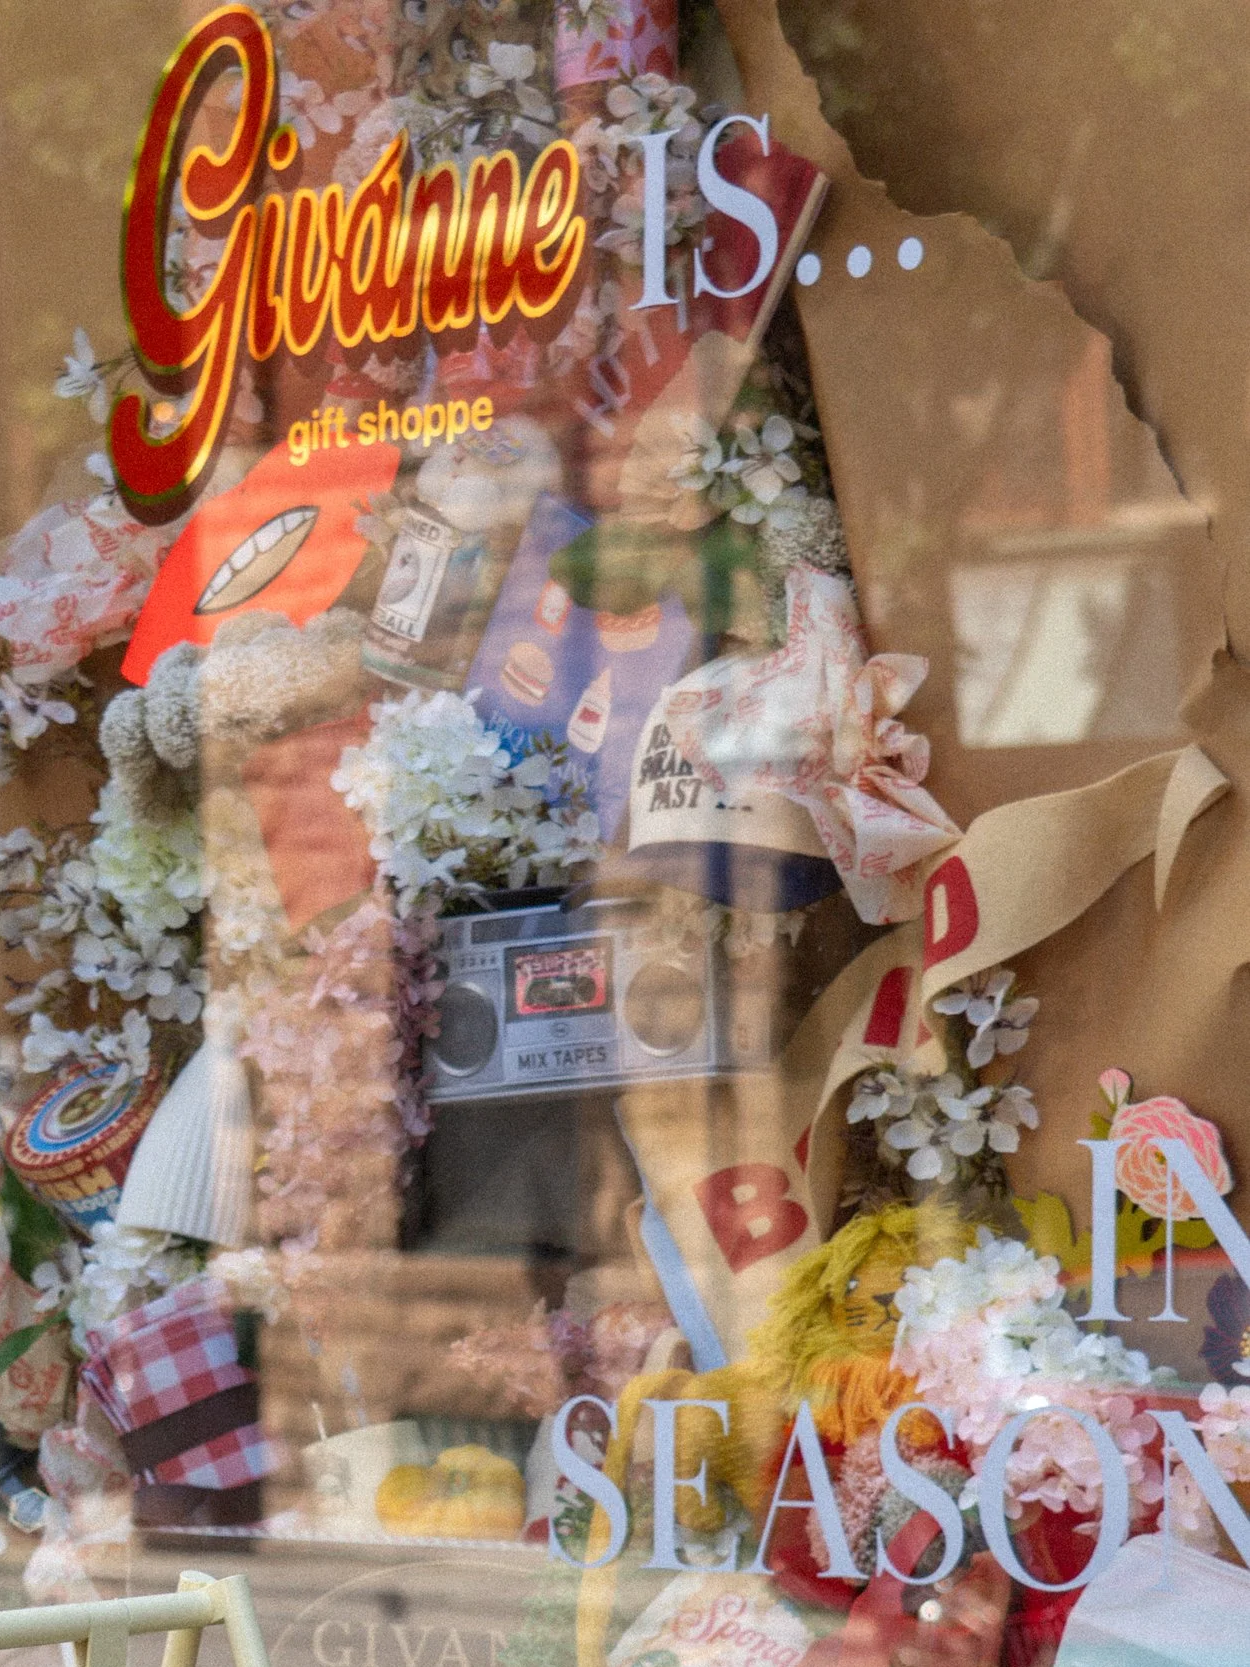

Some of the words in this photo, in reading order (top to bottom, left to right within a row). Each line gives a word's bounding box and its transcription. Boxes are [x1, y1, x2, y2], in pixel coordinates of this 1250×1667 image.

[288, 405, 350, 467] gift
[357, 394, 494, 448] shoppe
[517, 1050, 548, 1069] MIX
[553, 1045, 608, 1067] TAPES
[549, 1394, 1250, 1592] SEASON
